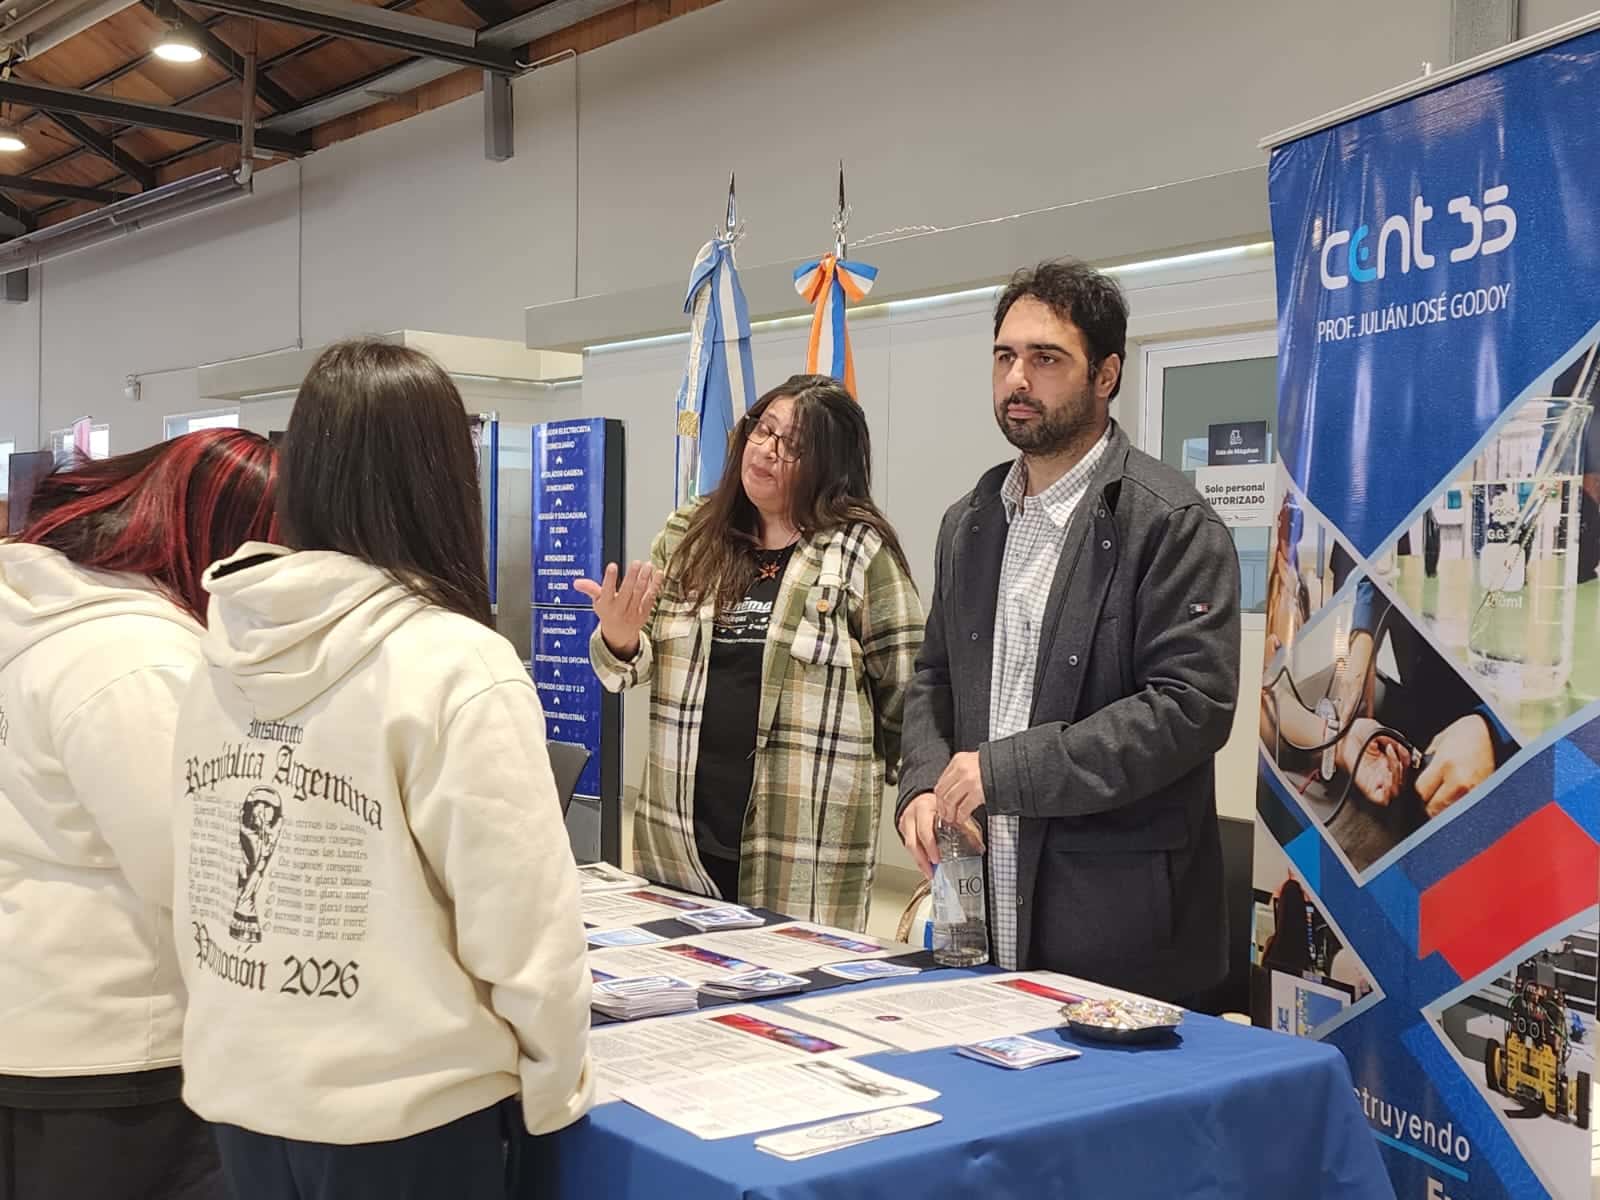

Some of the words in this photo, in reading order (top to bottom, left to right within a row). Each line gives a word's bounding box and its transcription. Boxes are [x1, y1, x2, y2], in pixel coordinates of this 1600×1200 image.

[1447, 184, 1518, 263] 35
[1318, 315, 1357, 343] PROF.
[1357, 302, 1408, 337] JULIÁN
[1408, 291, 1448, 328] JOSÉ
[1450, 282, 1512, 319] GODOY
[1205, 484, 1224, 493] Solo
[1225, 481, 1266, 496] personal
[247, 717, 304, 744] Instituto
[184, 741, 265, 798] República
[271, 743, 384, 831] Argentina
[280, 954, 360, 999] 2026
